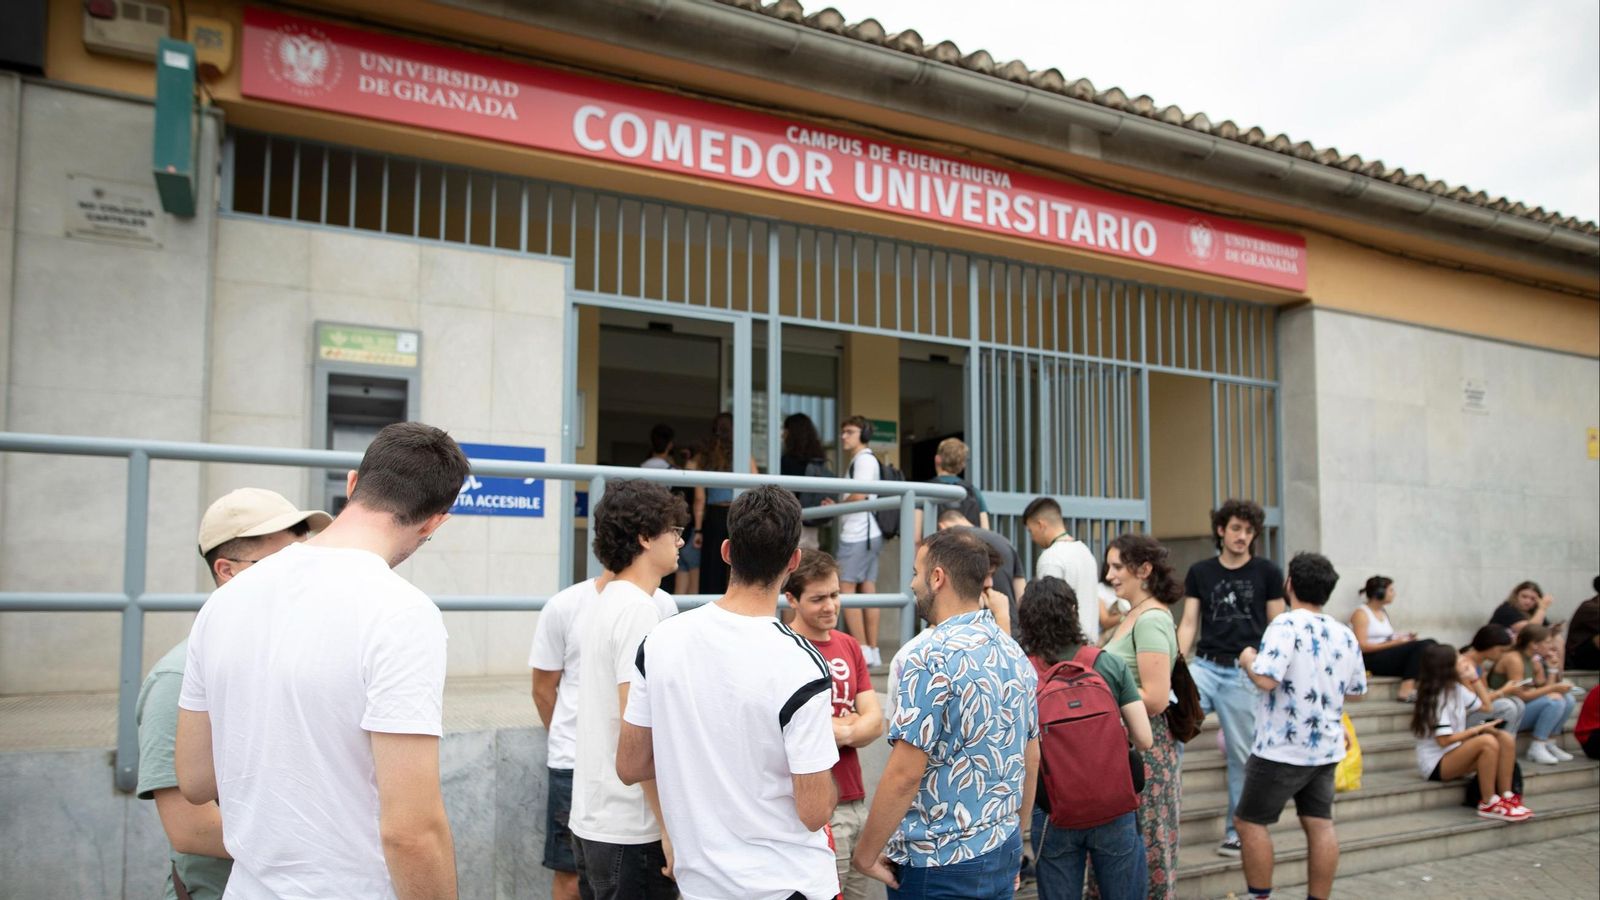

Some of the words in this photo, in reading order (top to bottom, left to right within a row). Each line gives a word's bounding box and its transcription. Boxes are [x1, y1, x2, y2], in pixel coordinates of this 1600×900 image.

[358, 74, 390, 97] DE
[393, 80, 518, 121] GRANADA
[359, 51, 519, 98] UNIVERSIDAD
[573, 105, 834, 194] COMEDOR
[855, 161, 1157, 257] UNIVERSITARIO
[786, 126, 863, 156] CAMPUS
[868, 144, 892, 163] DE
[898, 150, 1011, 189] FUENTENUEVA
[1224, 233, 1298, 259] UNIVERSIDAD
[1241, 251, 1299, 274] GRANADA
[476, 495, 541, 509] ACCESIBLE
